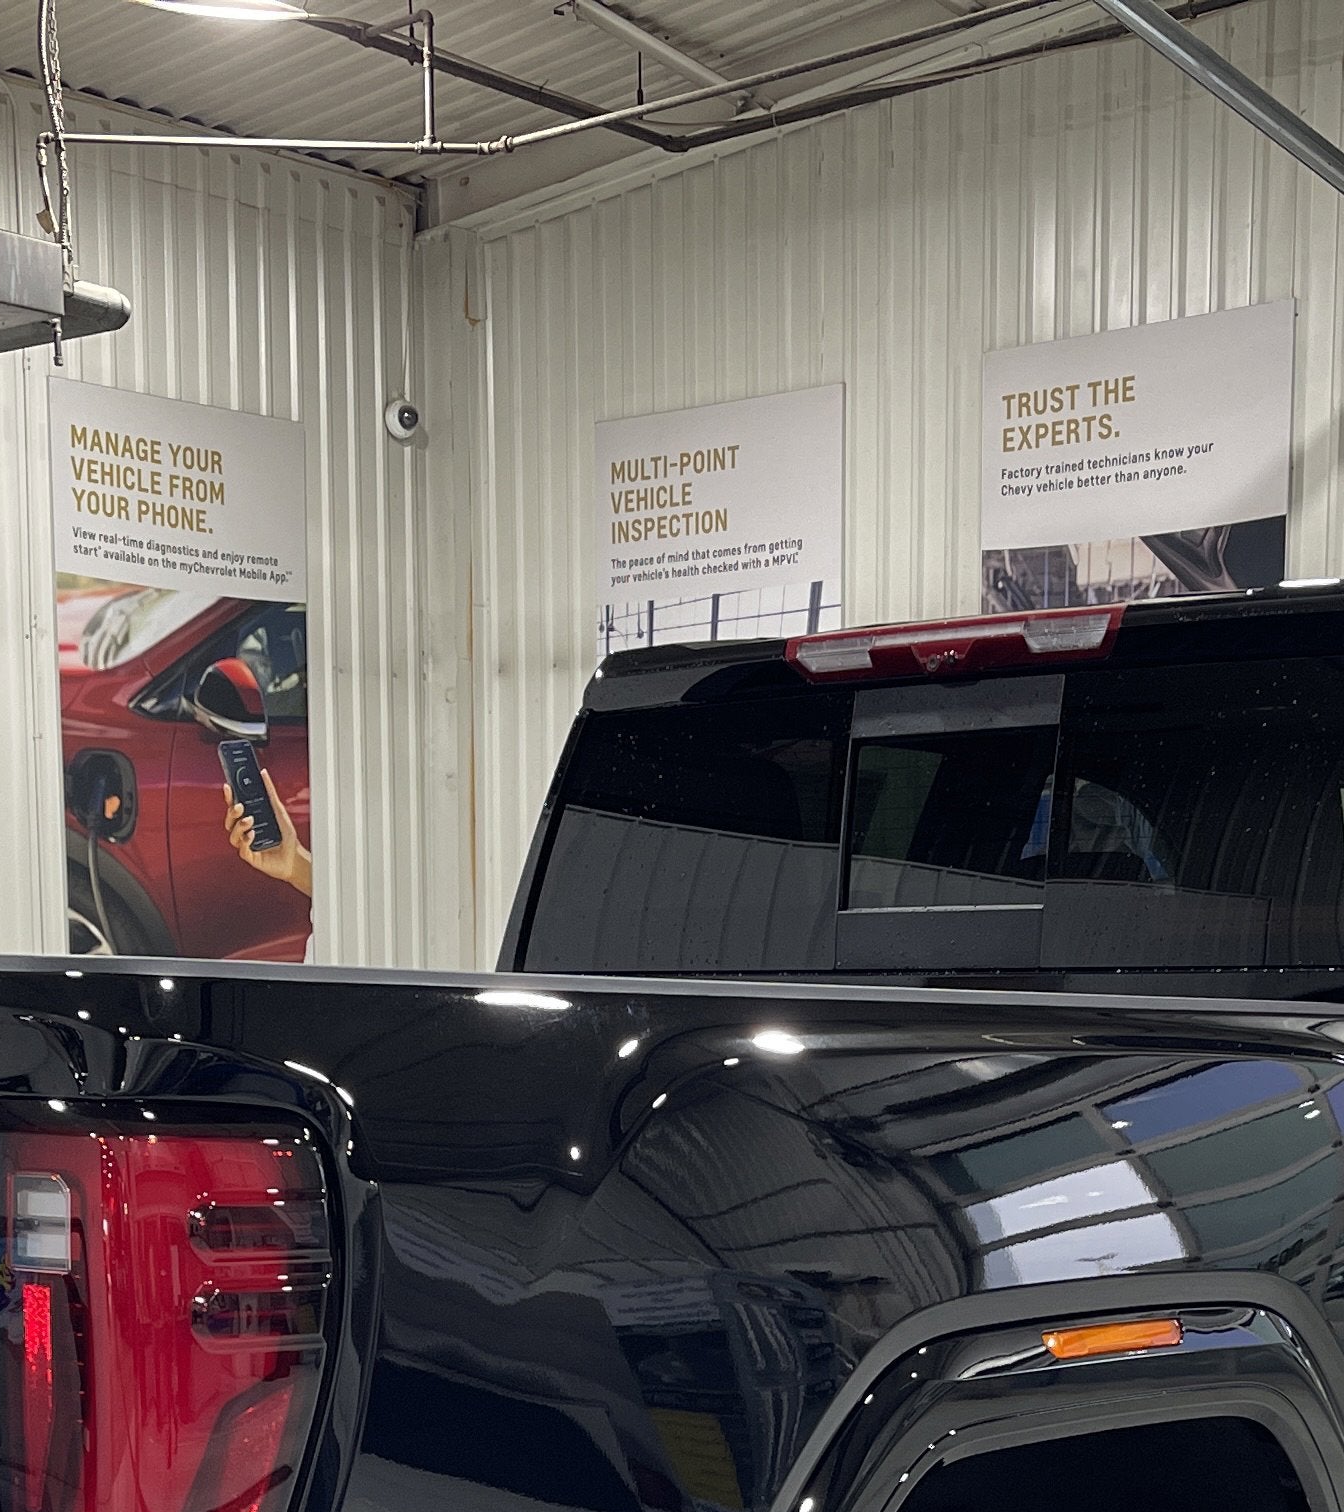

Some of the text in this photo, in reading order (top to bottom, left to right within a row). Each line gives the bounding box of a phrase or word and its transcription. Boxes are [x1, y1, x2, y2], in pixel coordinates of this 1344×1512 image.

[1001, 375, 1136, 420] TRUST THE
[70, 424, 223, 475] MANAGE YOUR
[1002, 413, 1121, 453] EXPERTS.
[70, 455, 225, 505] VEHICLE FROM
[611, 445, 740, 484] MULTI-POINT
[1001, 441, 1214, 480] Factory trained technicians know your
[611, 482, 693, 514] VEHICLE
[1001, 464, 1187, 497] Chevy vehicle better than anyone.
[71, 487, 214, 534] YOUR PHONE.
[611, 508, 728, 544] INSPECTION
[72, 525, 279, 567] View real-time diagnostics and enjoy remote
[103, 547, 145, 566] available
[147, 556, 159, 567] on
[161, 556, 177, 570] the
[179, 561, 237, 578] myChevrolet
[239, 565, 267, 581] Mobile
[611, 538, 803, 571] The peace of mind that comes from getting
[611, 575, 630, 587] your
[632, 568, 670, 583] vehicle's
[671, 564, 700, 578] health
[701, 559, 739, 575] checked
[741, 557, 762, 570] with
[764, 559, 770, 568] a
